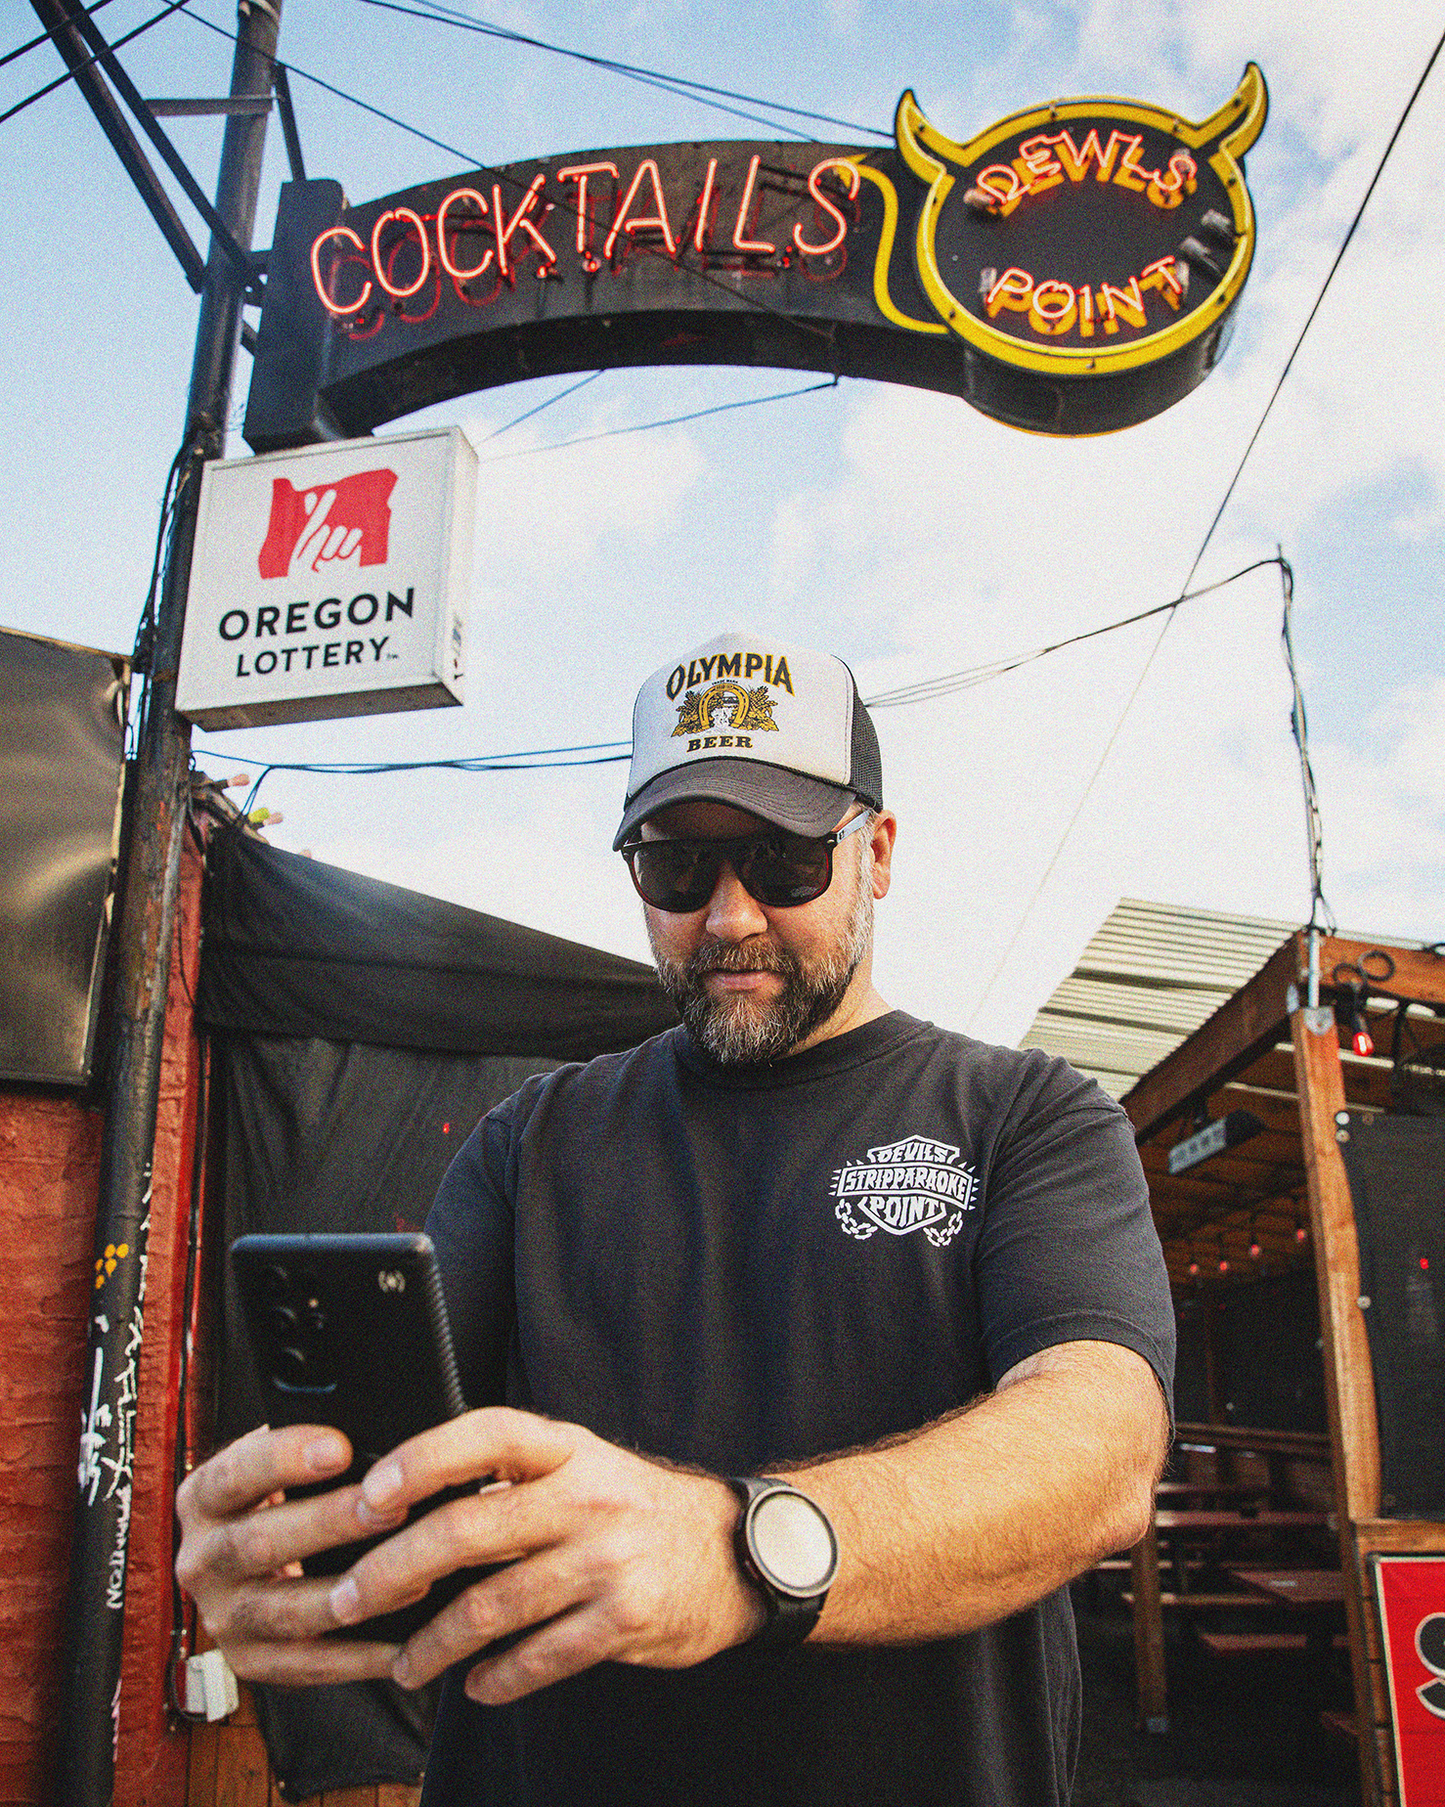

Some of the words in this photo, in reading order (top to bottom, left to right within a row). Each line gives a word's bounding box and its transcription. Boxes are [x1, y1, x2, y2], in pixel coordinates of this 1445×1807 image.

[310, 155, 861, 315] COCKTAILS
[985, 255, 1184, 337] POINT
[218, 587, 414, 641] OREGON
[236, 636, 389, 677] LOTTERY
[666, 652, 795, 702] OLYMPIA
[686, 736, 753, 753] BEER
[876, 1142, 949, 1163] DEVILS
[844, 1167, 967, 1202] STRIPPARAOKE
[869, 1196, 939, 1227] POINT
